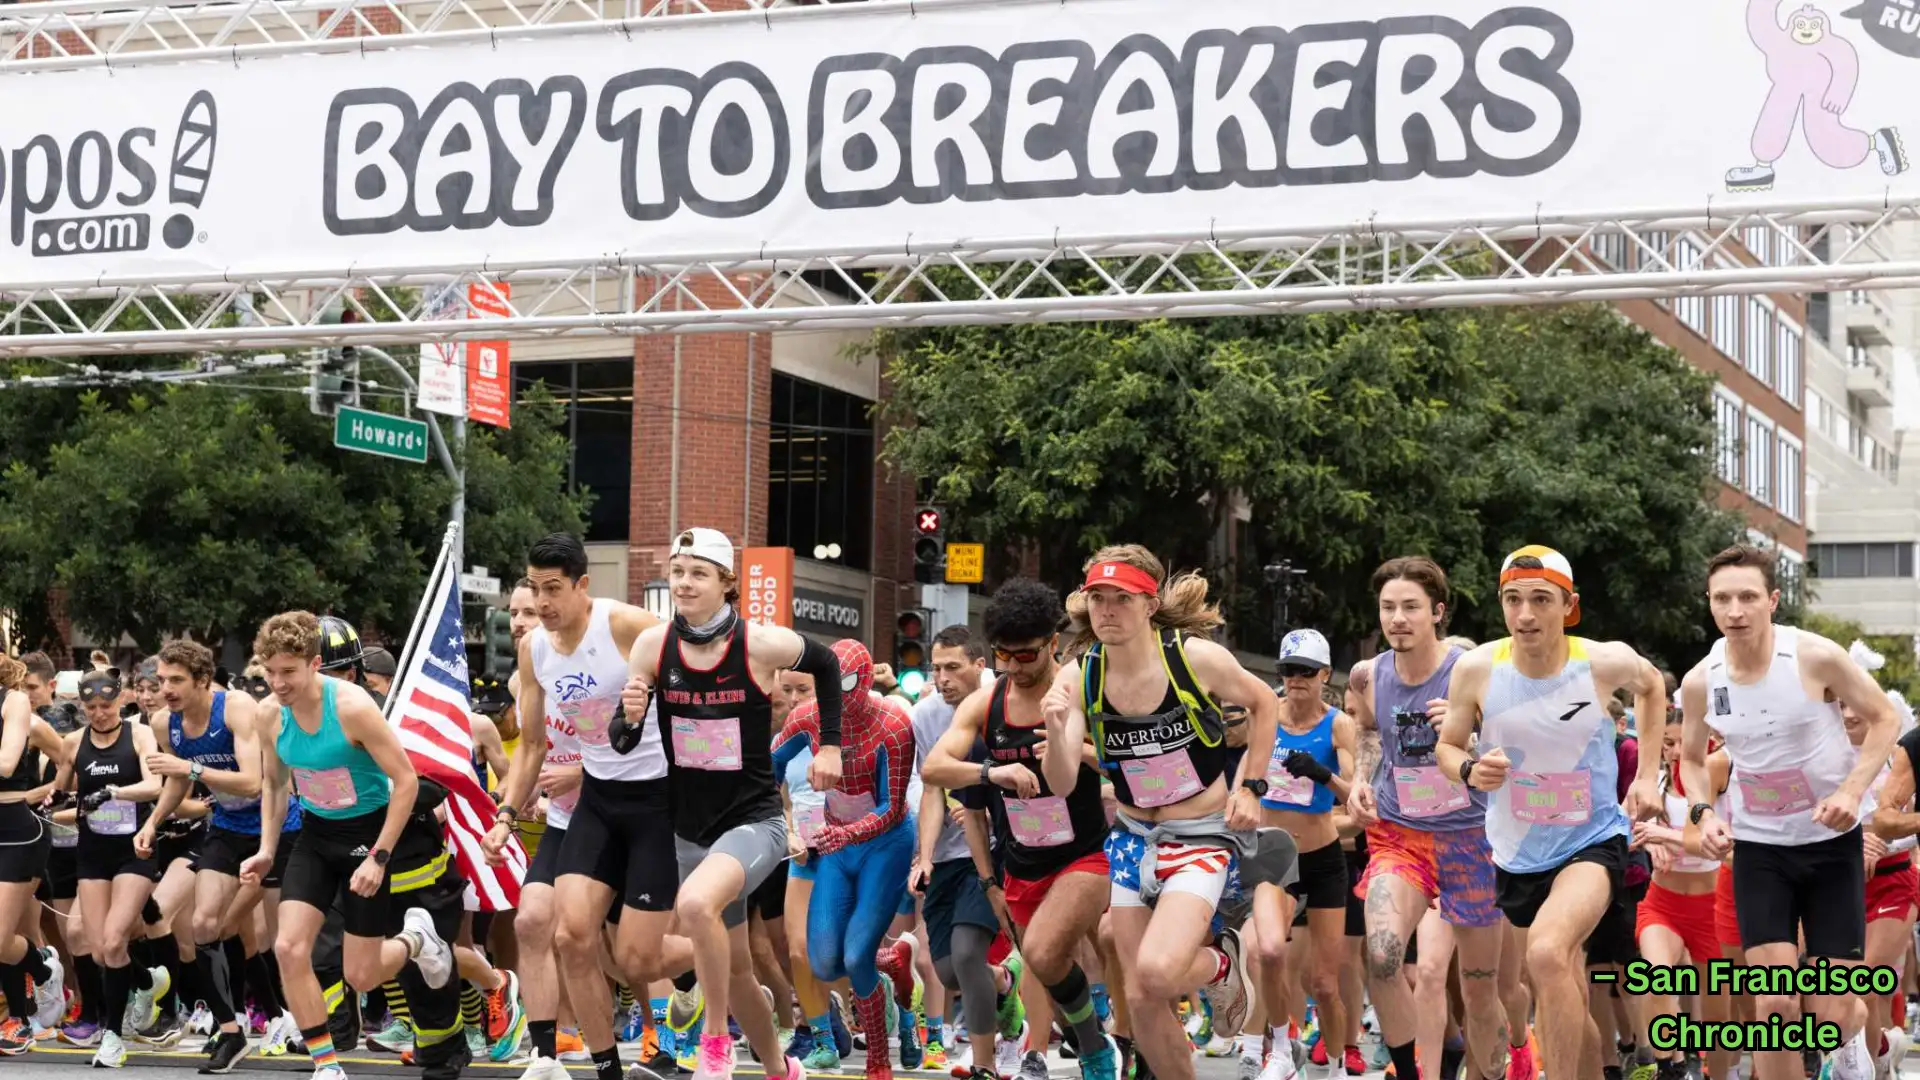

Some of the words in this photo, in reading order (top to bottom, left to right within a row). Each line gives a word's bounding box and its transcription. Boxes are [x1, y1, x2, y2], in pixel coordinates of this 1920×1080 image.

[324, 76, 588, 235] BAY
[597, 62, 790, 220] TO
[806, 8, 1580, 209] BREAKERS
[37, 216, 139, 252] .com
[352, 418, 414, 450] Howard
[763, 576, 777, 627] FOOD
[827, 605, 860, 628] FOOD
[1104, 719, 1195, 747] AVERFOR
